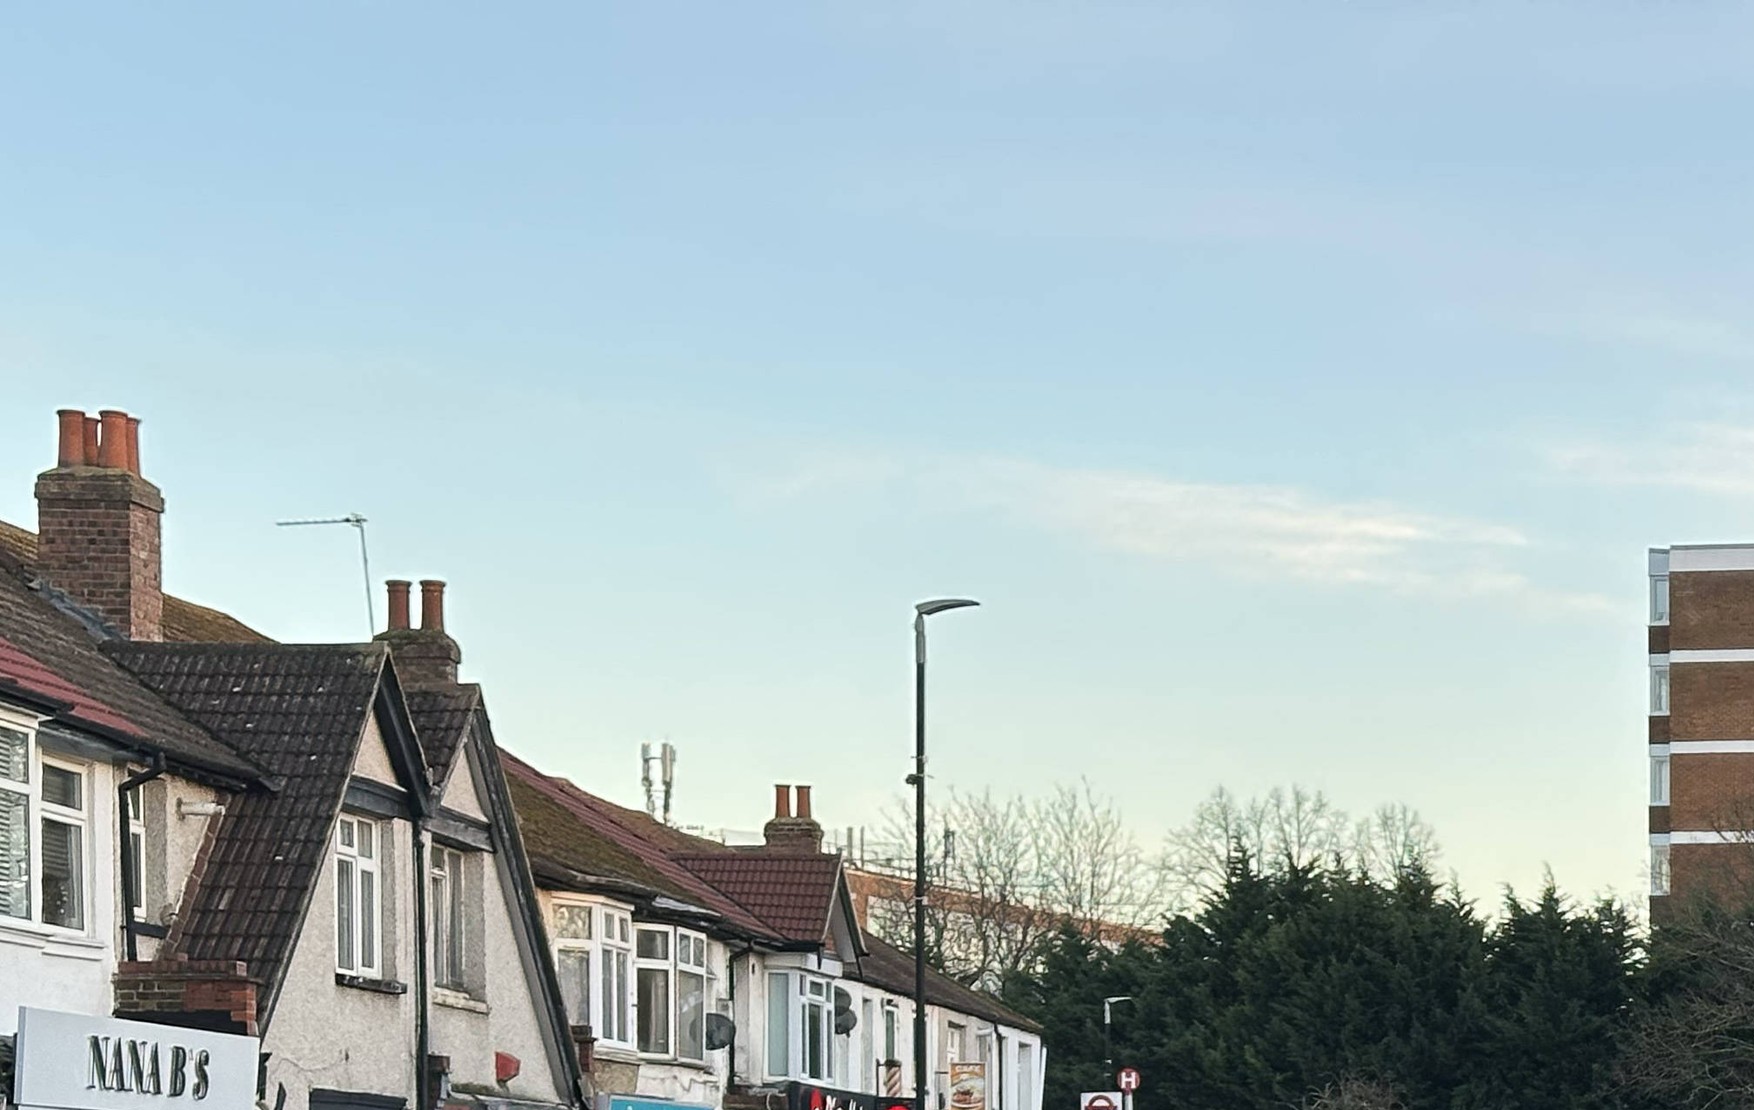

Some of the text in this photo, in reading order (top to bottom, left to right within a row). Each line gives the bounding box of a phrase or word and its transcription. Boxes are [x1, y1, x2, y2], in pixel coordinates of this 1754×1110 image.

[86, 1035, 210, 1102] NANA B'S
[1121, 1071, 1136, 1089] H
